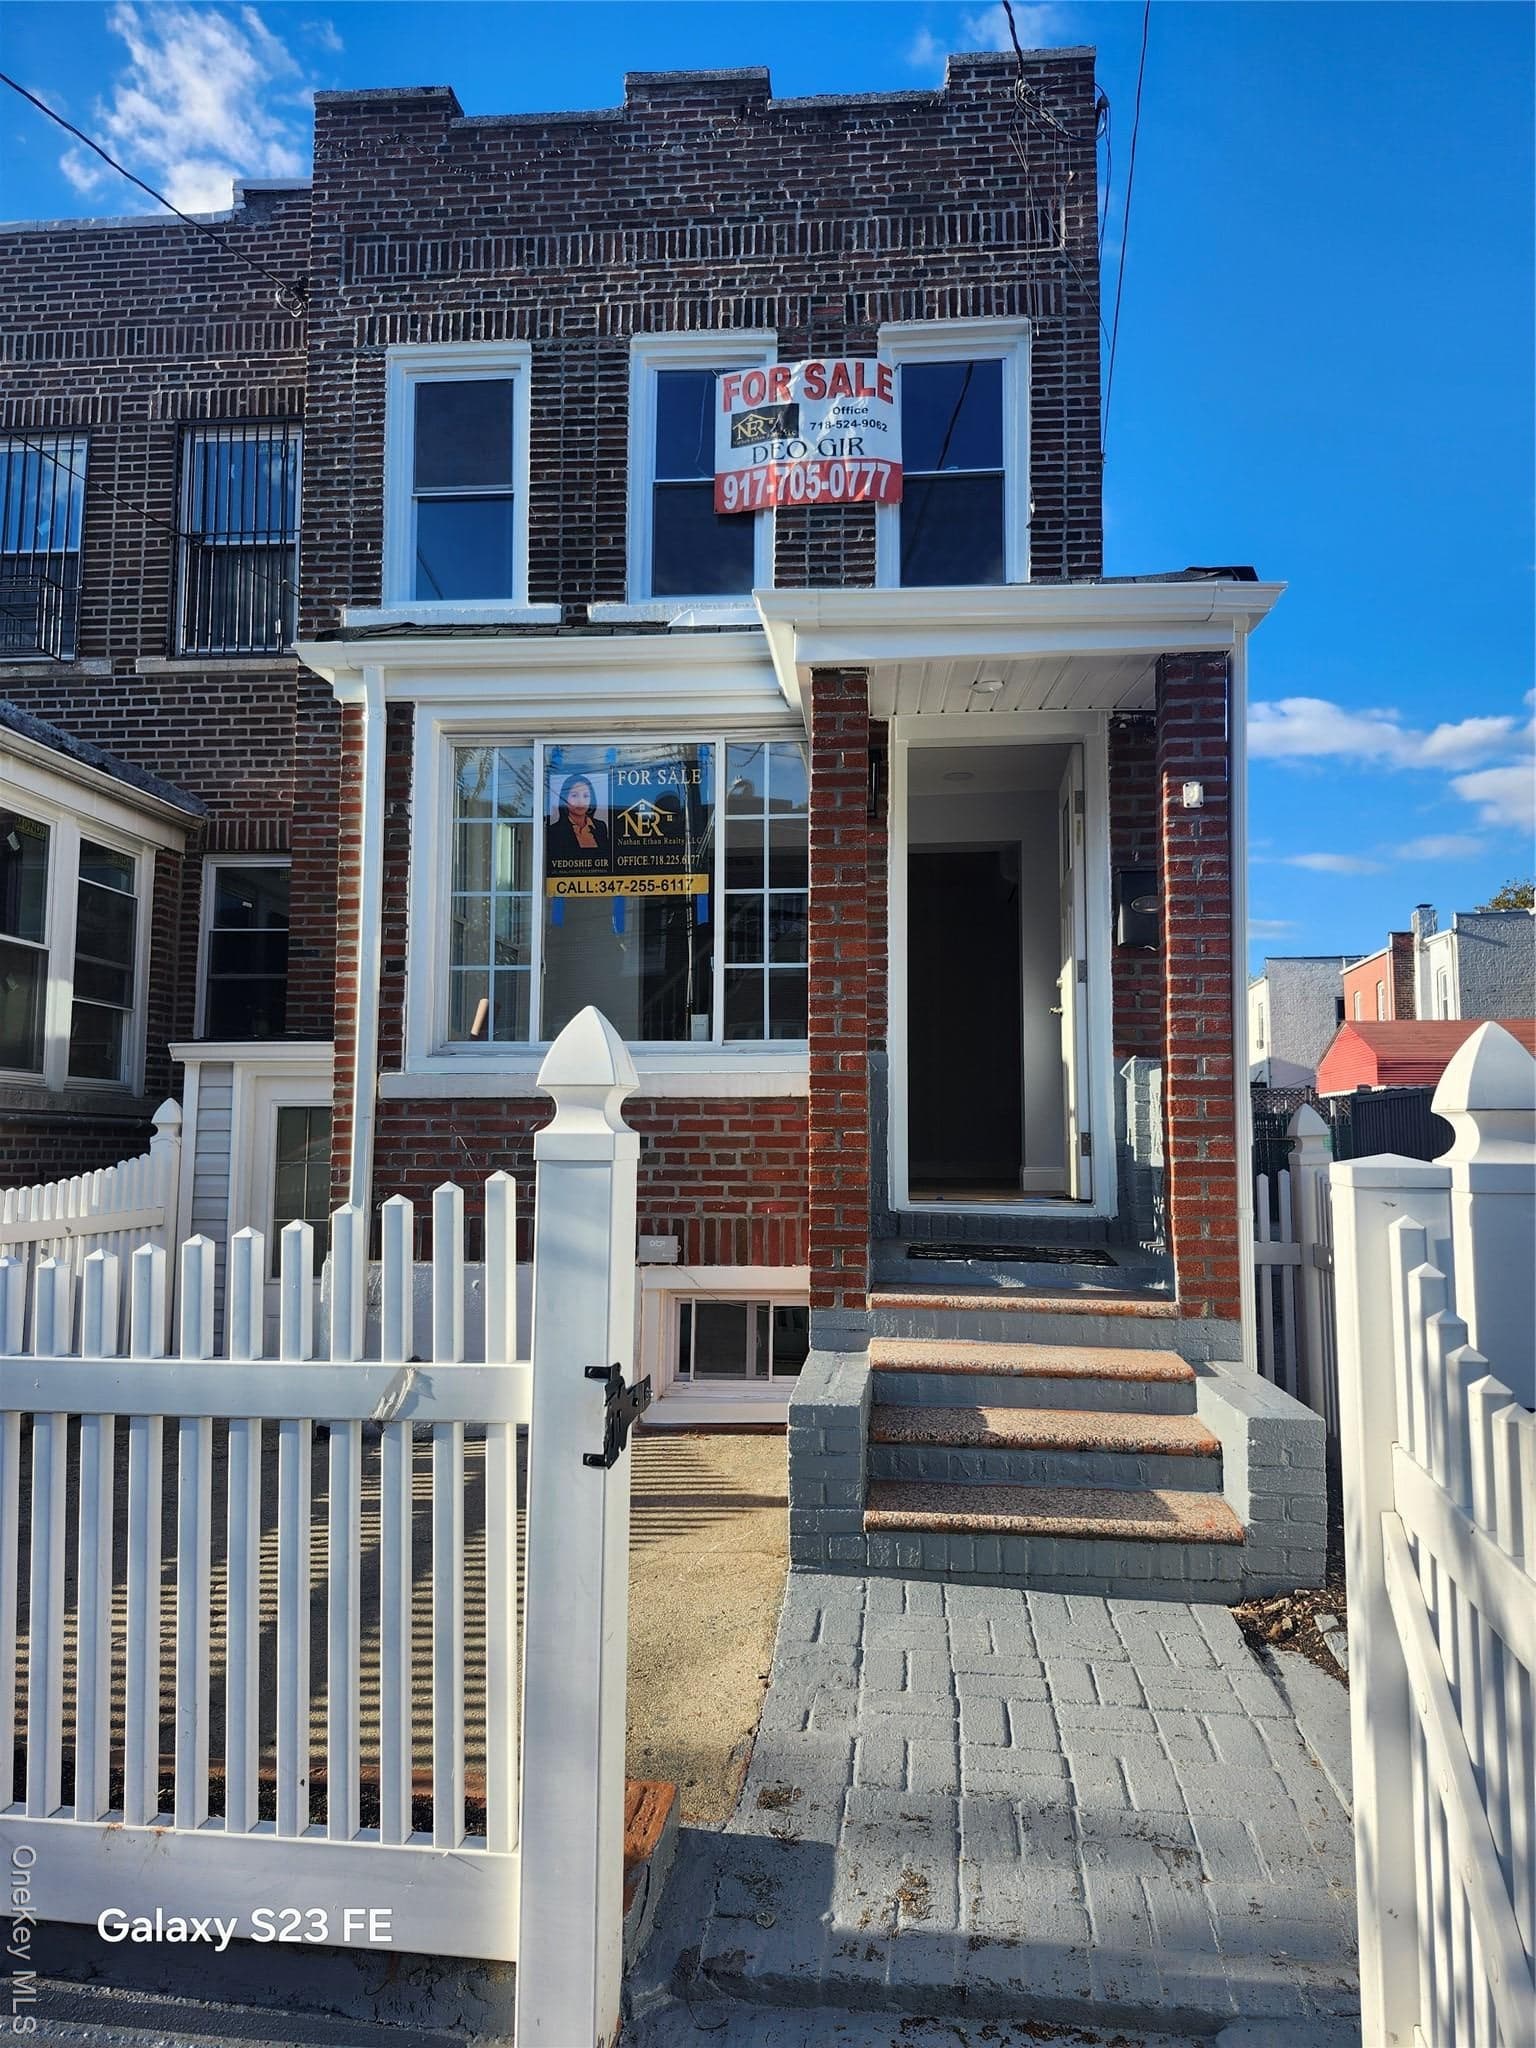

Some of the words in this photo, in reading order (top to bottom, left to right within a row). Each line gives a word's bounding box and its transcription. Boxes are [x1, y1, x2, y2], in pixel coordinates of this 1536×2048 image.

[722, 366, 793, 412] FOR
[803, 362, 894, 404] SALE
[832, 406, 869, 415] Office
[809, 419, 888, 432] 718-524-9062
[752, 440, 807, 464] DEO
[817, 437, 865, 456] GIR
[723, 463, 891, 509] 917-705-0777
[618, 770, 652, 785] FOR
[657, 768, 703, 784] SALE
[623, 811, 664, 837] NER
[551, 859, 593, 868] VEDOSHIE
[594, 859, 609, 867] GIR
[556, 879, 694, 894] CALL:347-255-6117
